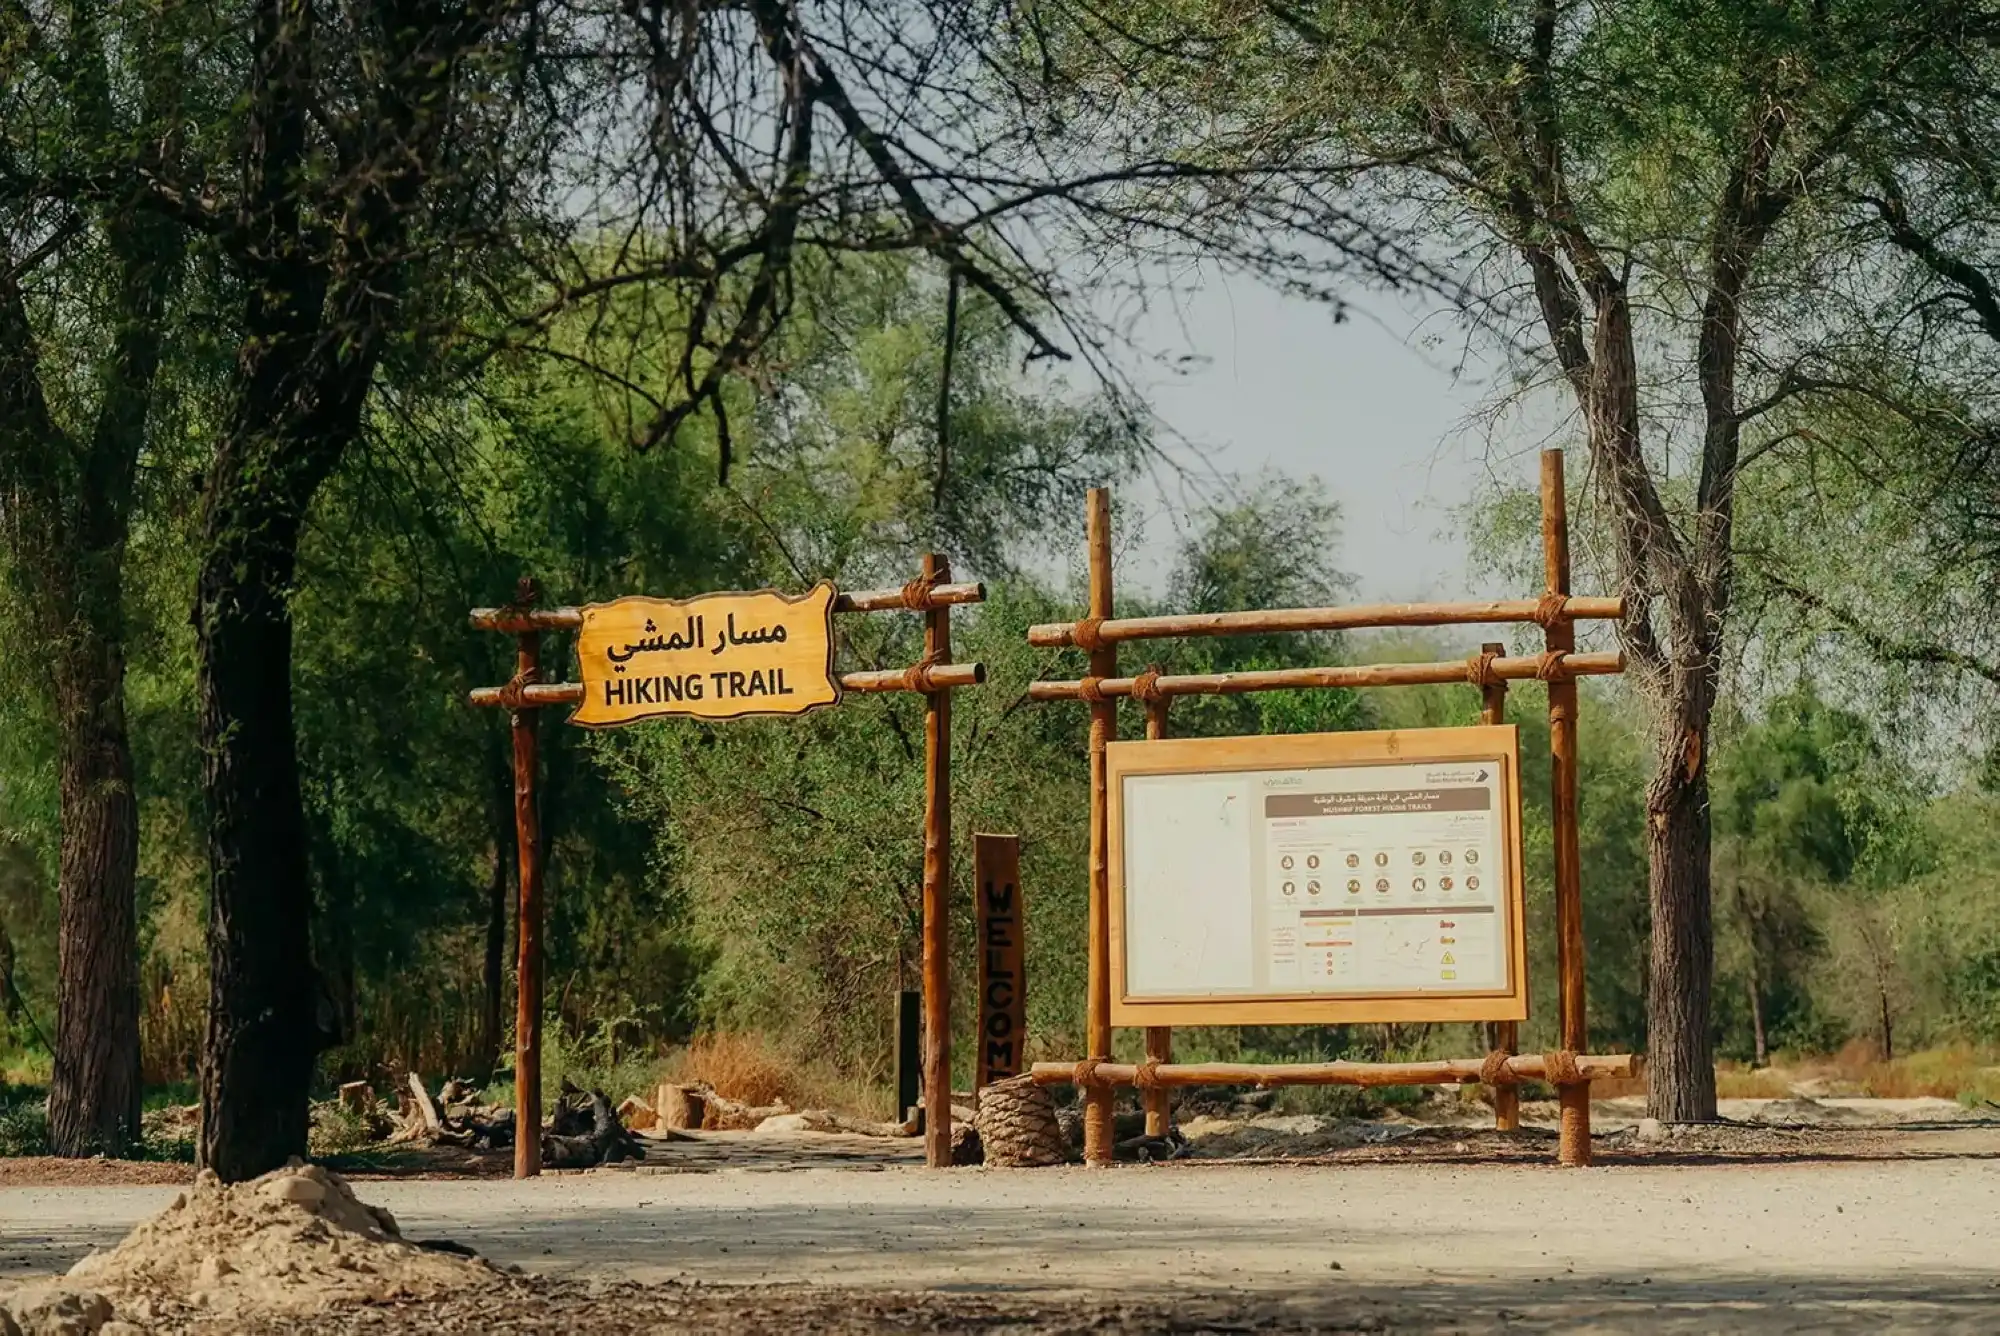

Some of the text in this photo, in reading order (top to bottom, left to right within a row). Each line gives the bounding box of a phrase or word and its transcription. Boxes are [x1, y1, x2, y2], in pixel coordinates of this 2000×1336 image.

[607, 613, 787, 673] مسار المشي
[604, 668, 794, 706] HIKING TRAIL
[1354, 804, 1381, 813] FOREST
[1407, 802, 1433, 811] TRAILS
